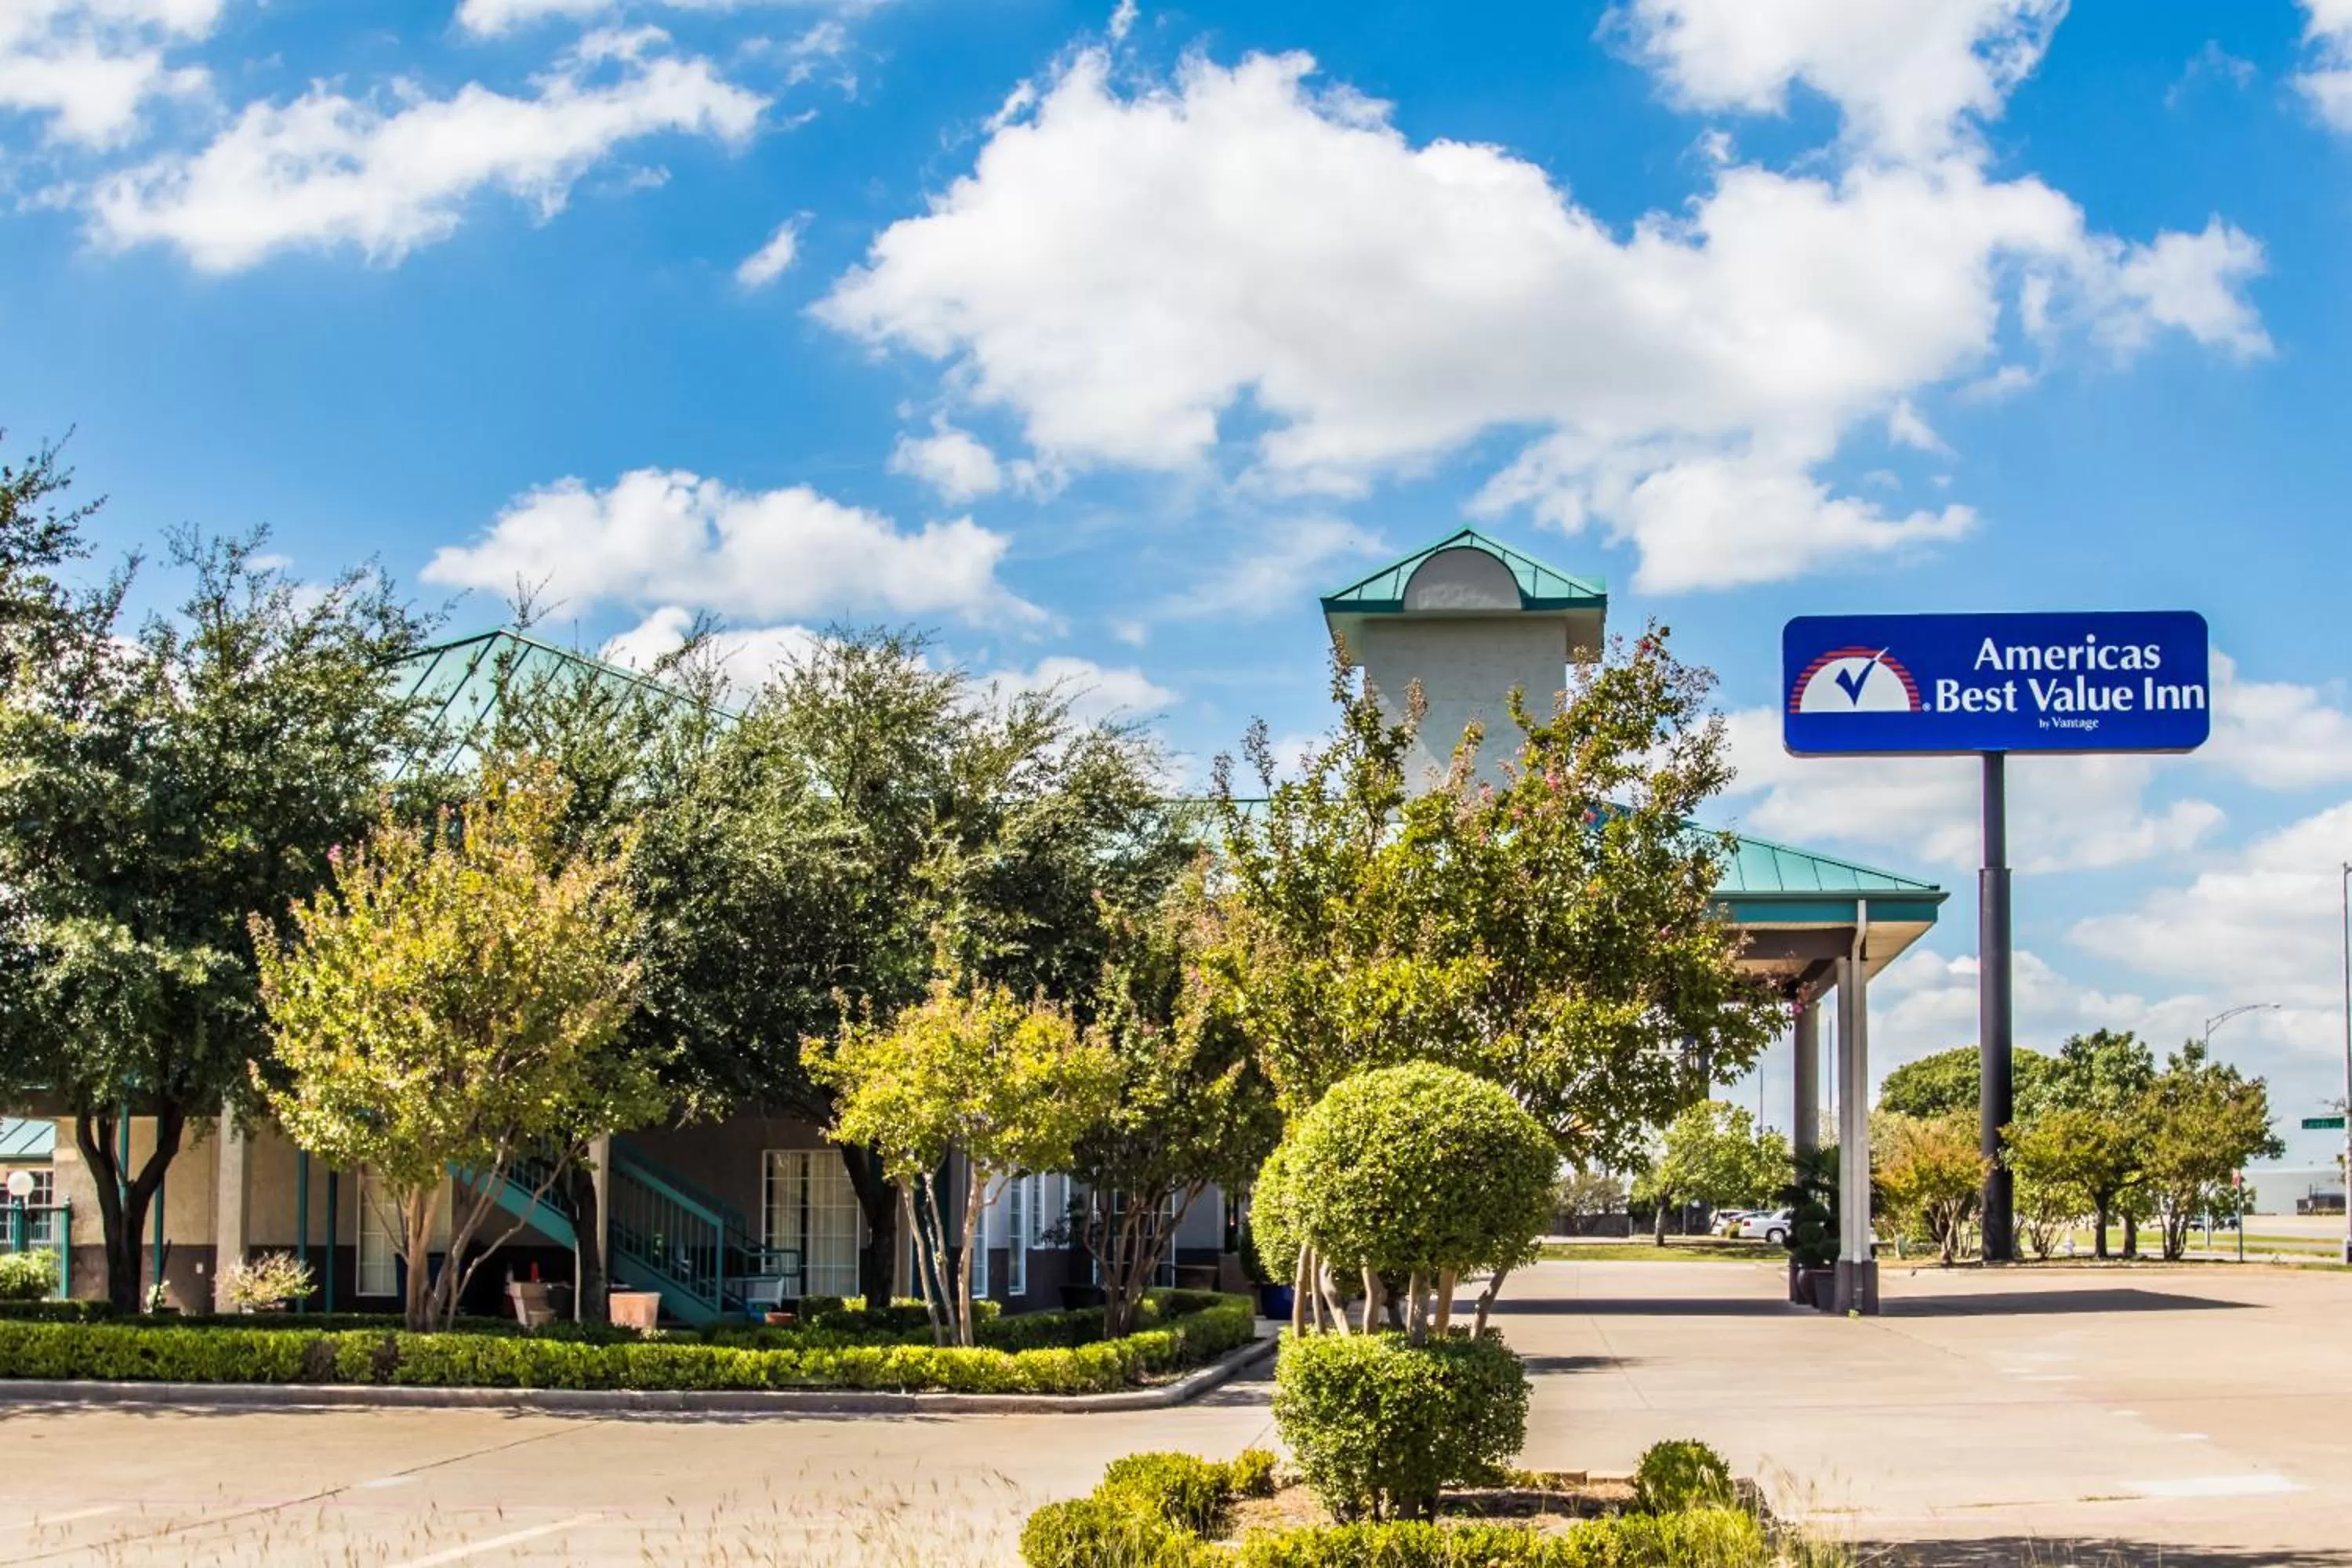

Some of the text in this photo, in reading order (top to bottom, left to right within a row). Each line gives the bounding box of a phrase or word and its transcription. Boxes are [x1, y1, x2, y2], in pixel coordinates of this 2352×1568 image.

[1973, 633, 2161, 670] Americas
[1936, 675, 2205, 712] Best Value Inn
[2051, 717, 2099, 731] Vantage
